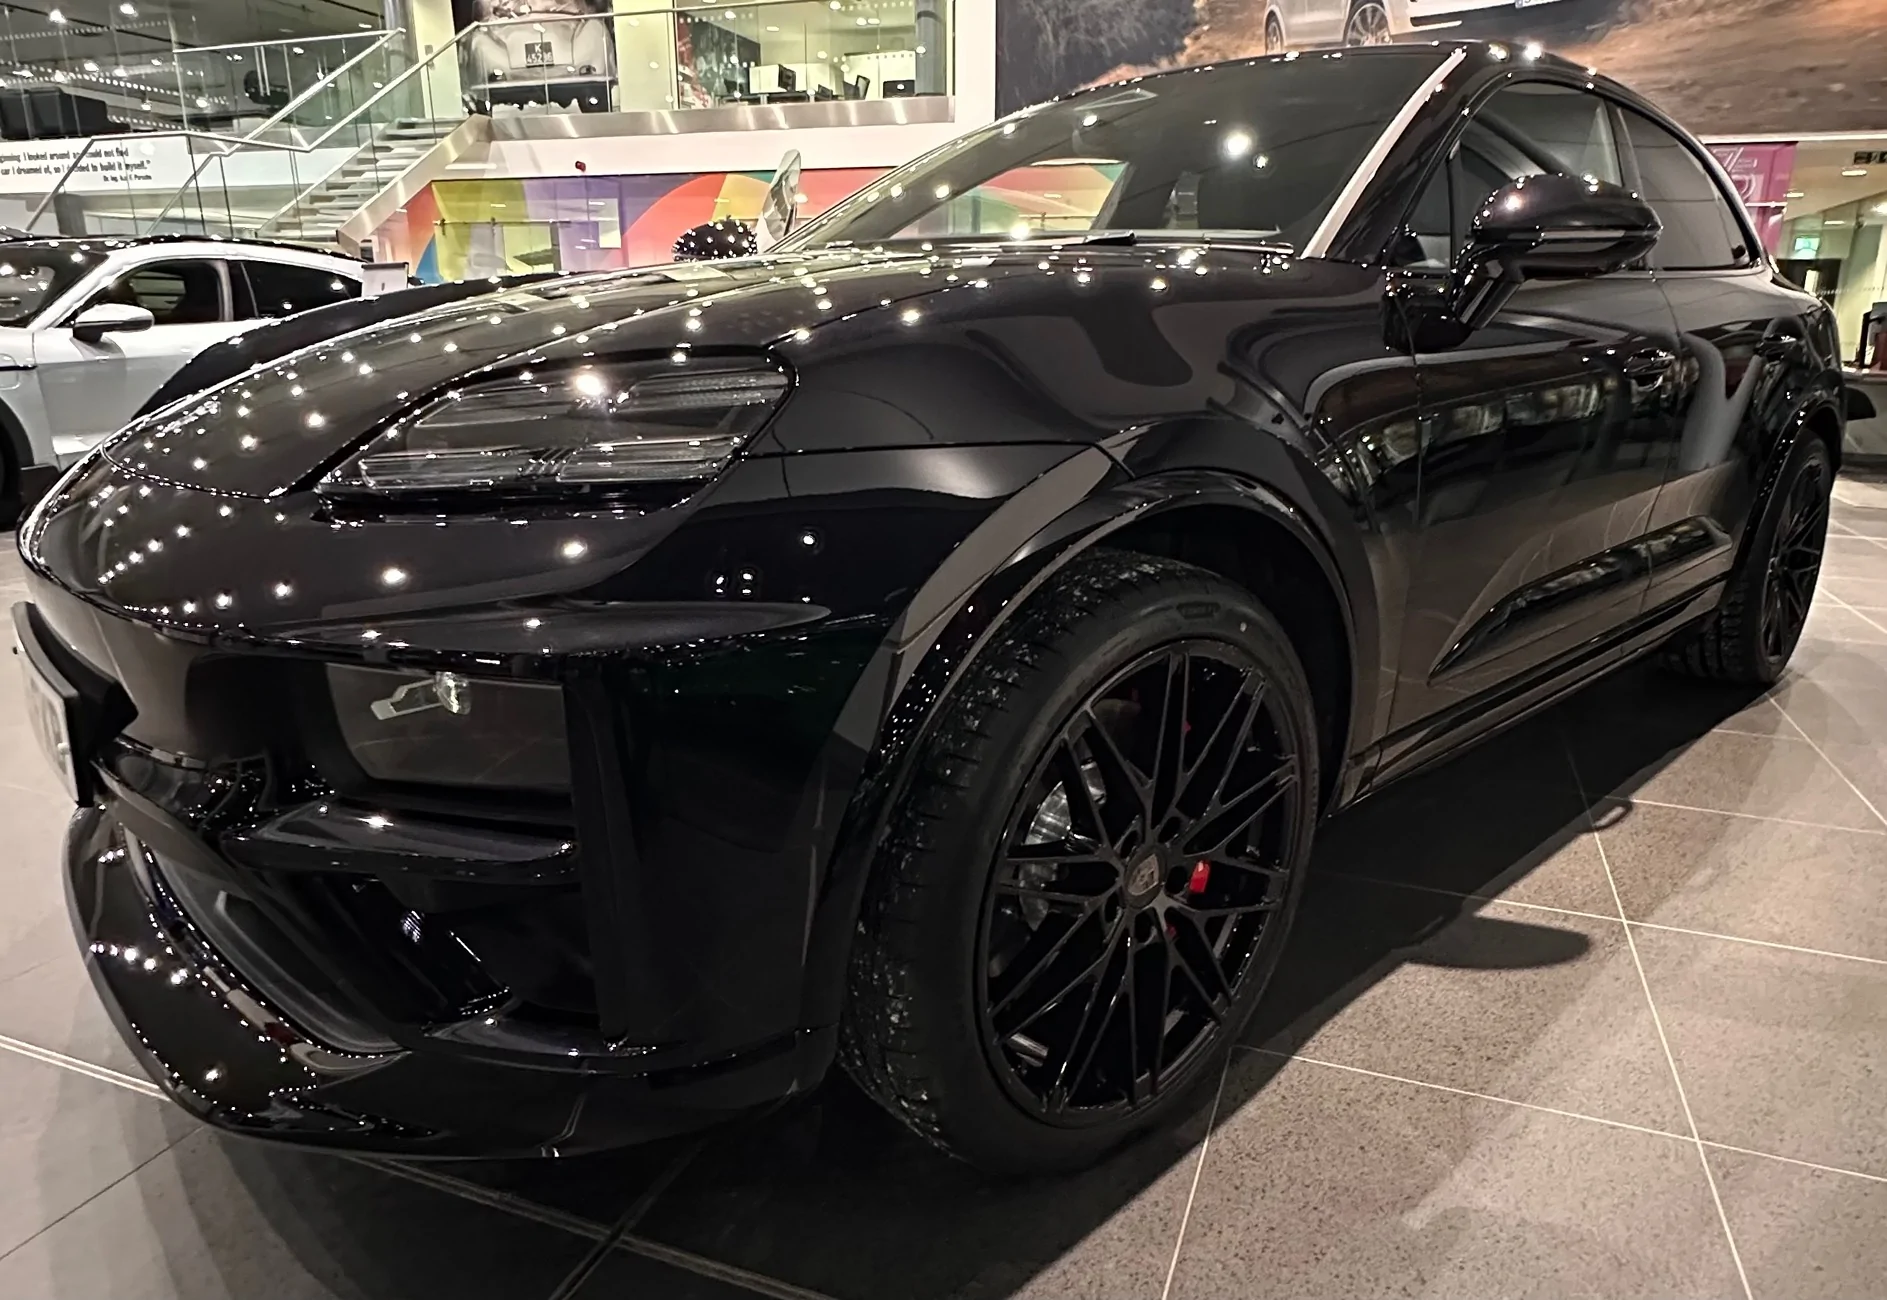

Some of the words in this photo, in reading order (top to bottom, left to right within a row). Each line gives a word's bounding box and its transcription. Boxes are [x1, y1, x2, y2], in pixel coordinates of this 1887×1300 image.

[535, 43, 542, 53] K
[27, 151, 48, 160] looked
[49, 150, 70, 160] around
